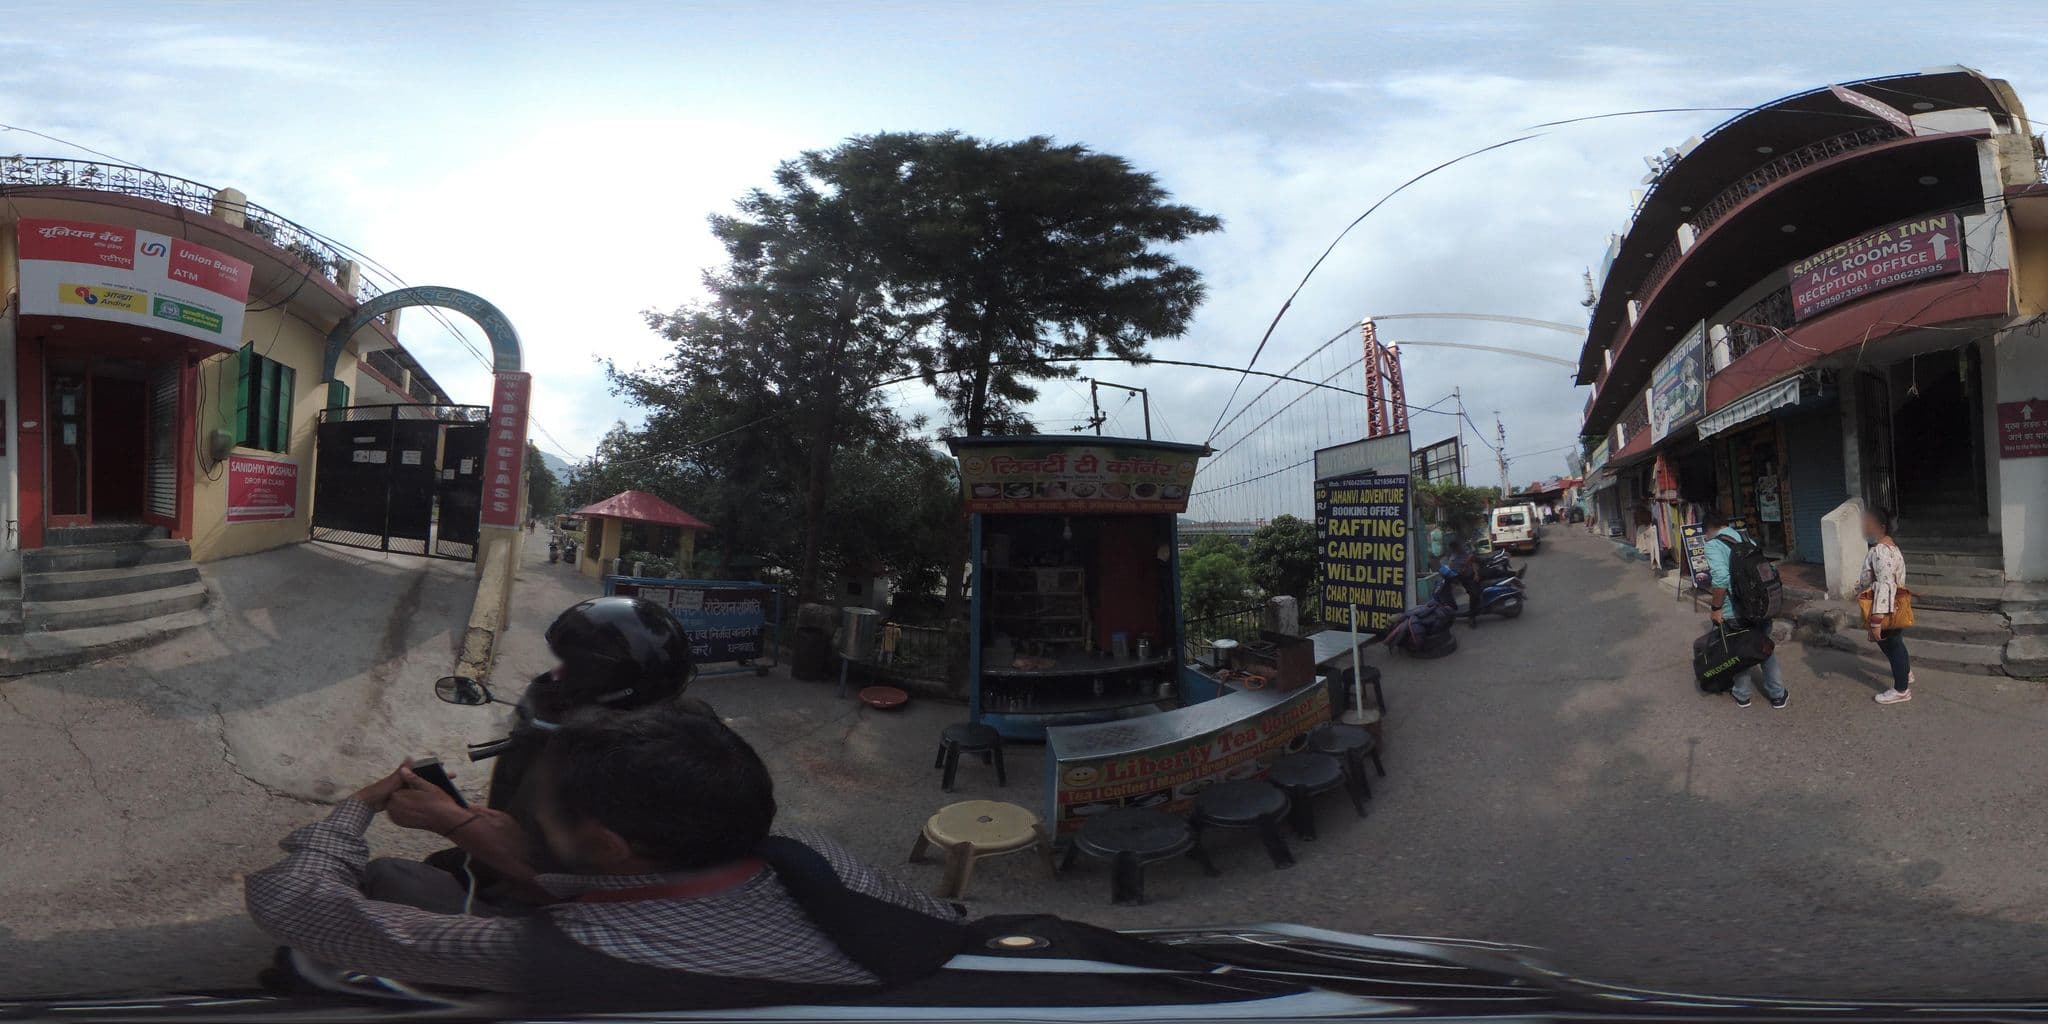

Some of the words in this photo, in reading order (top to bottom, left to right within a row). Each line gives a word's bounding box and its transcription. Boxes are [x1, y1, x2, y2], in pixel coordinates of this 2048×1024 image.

[38, 226, 96, 238] यूनियन
[1793, 230, 1892, 277] SANIDHYA
[1899, 216, 1947, 237] INN
[1842, 239, 1913, 271] ROOMS
[100, 253, 131, 264] एटीएम
[180, 249, 211, 265] Union
[214, 259, 239, 276] Bank
[174, 268, 198, 281] ATM
[1798, 269, 1868, 306] RECEPTION
[1871, 251, 1928, 275] OFFICE
[231, 461, 266, 474] SANIDHYA
[989, 454, 1068, 475] लिबर्टी
[1074, 454, 1099, 474] टी
[493, 447, 513, 512] CLASS
[1330, 489, 1358, 505] JAHANVI
[1360, 488, 1404, 504] ADVENTURE
[1332, 506, 1367, 517] BOOKING
[1370, 505, 1400, 516] OFFICE
[1328, 519, 1405, 538] RAFTING
[1327, 541, 1405, 561] CAMPING
[1327, 562, 1404, 586] WILDLIFE
[1325, 585, 1347, 602] CHAR
[1349, 586, 1373, 606] DHAM
[1375, 589, 1403, 609] YATRA
[1325, 606, 1350, 624] BIKE
[1703, 656, 1741, 679] WILDCRAFT
[1104, 744, 1210, 782] Liberty
[1217, 728, 1257, 752] Tea
[1068, 790, 1093, 802] Tea
